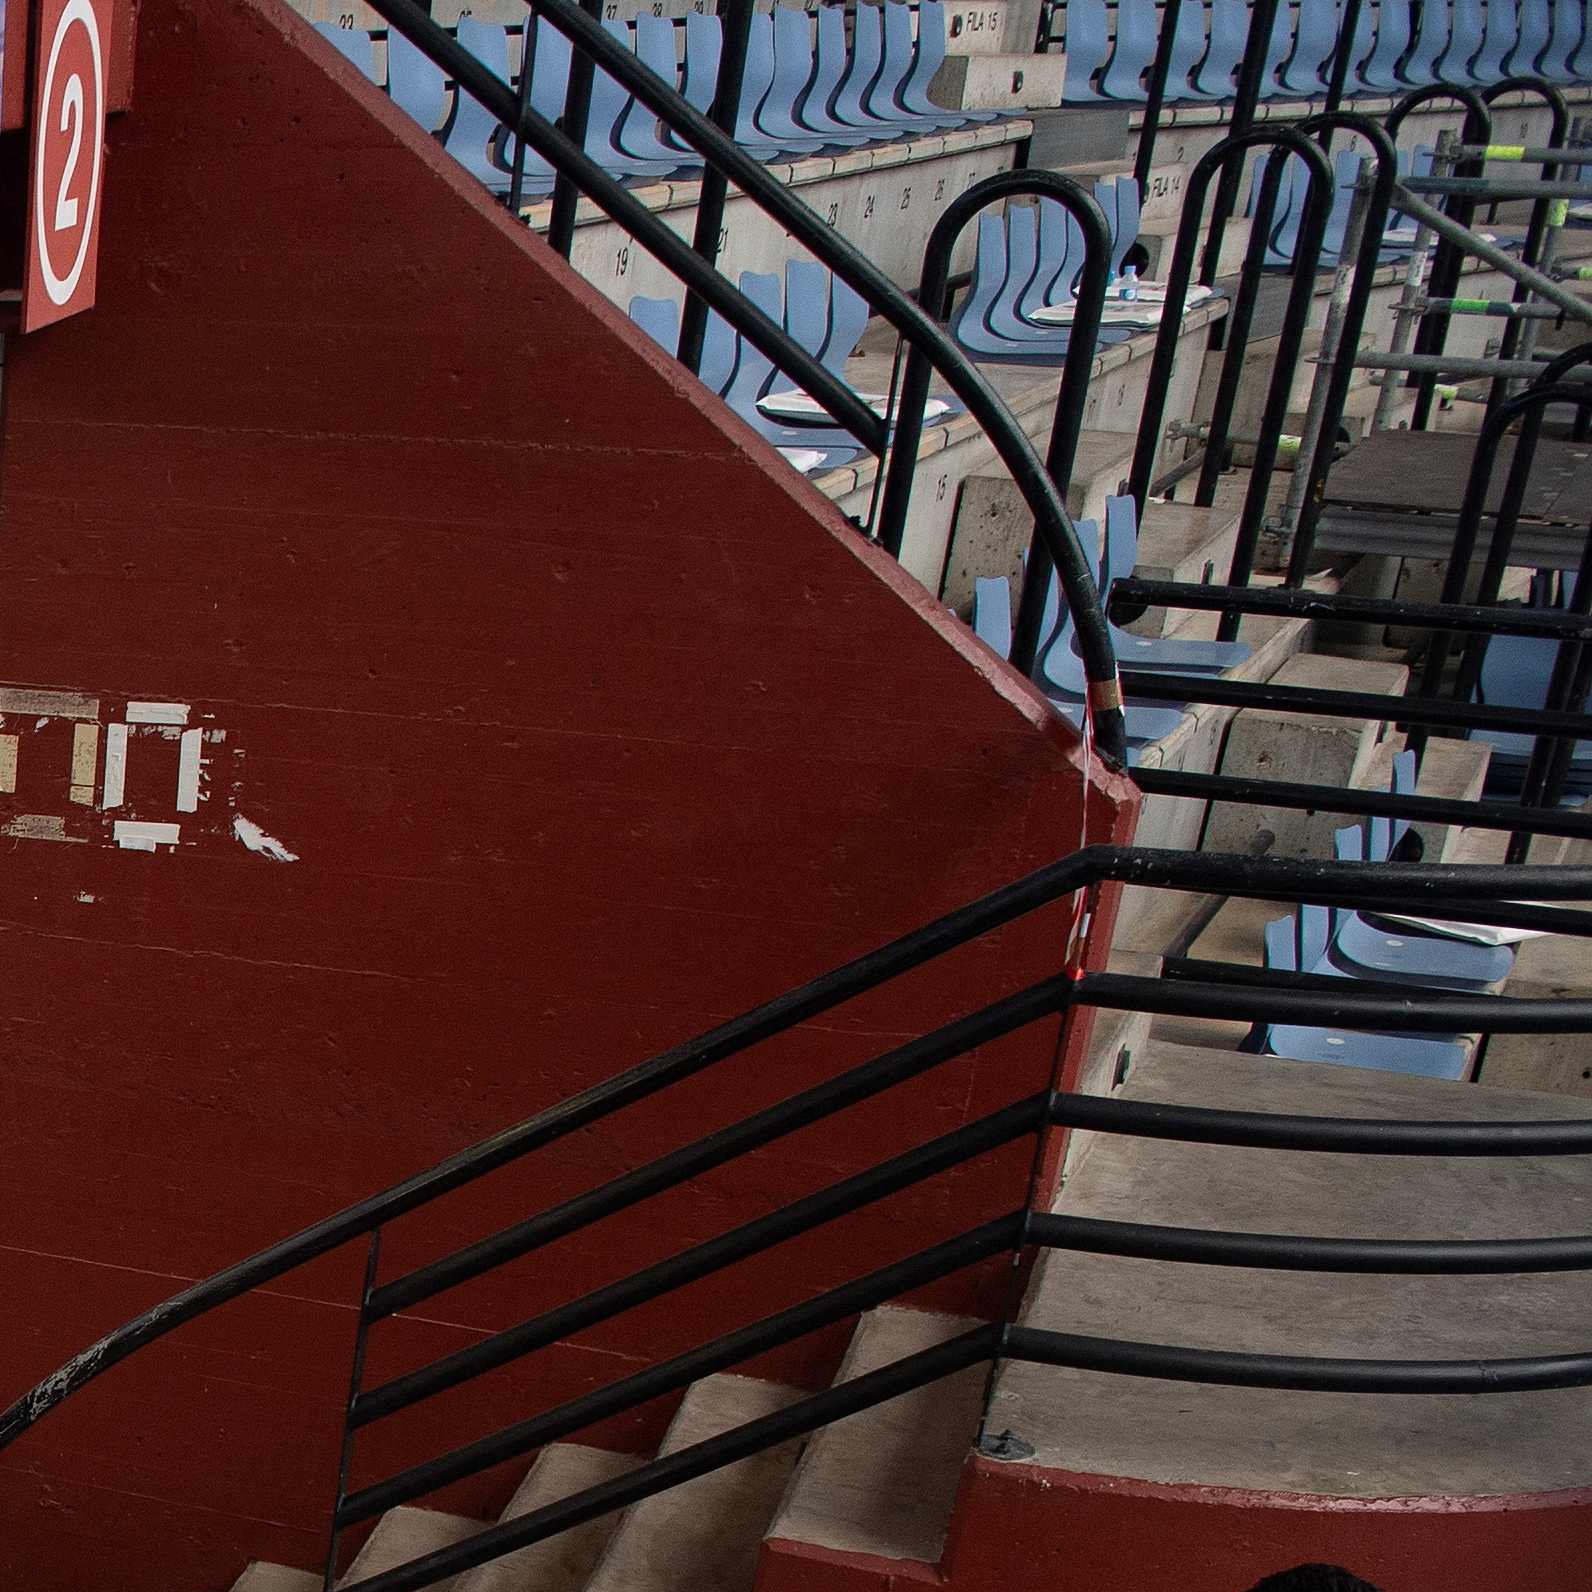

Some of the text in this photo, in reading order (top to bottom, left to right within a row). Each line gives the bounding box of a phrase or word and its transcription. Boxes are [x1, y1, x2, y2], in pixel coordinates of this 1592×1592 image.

[967, 11, 984, 32] FILA
[54, 73, 85, 230] 2
[864, 194, 876, 219] 24
[616, 247, 628, 277] 19
